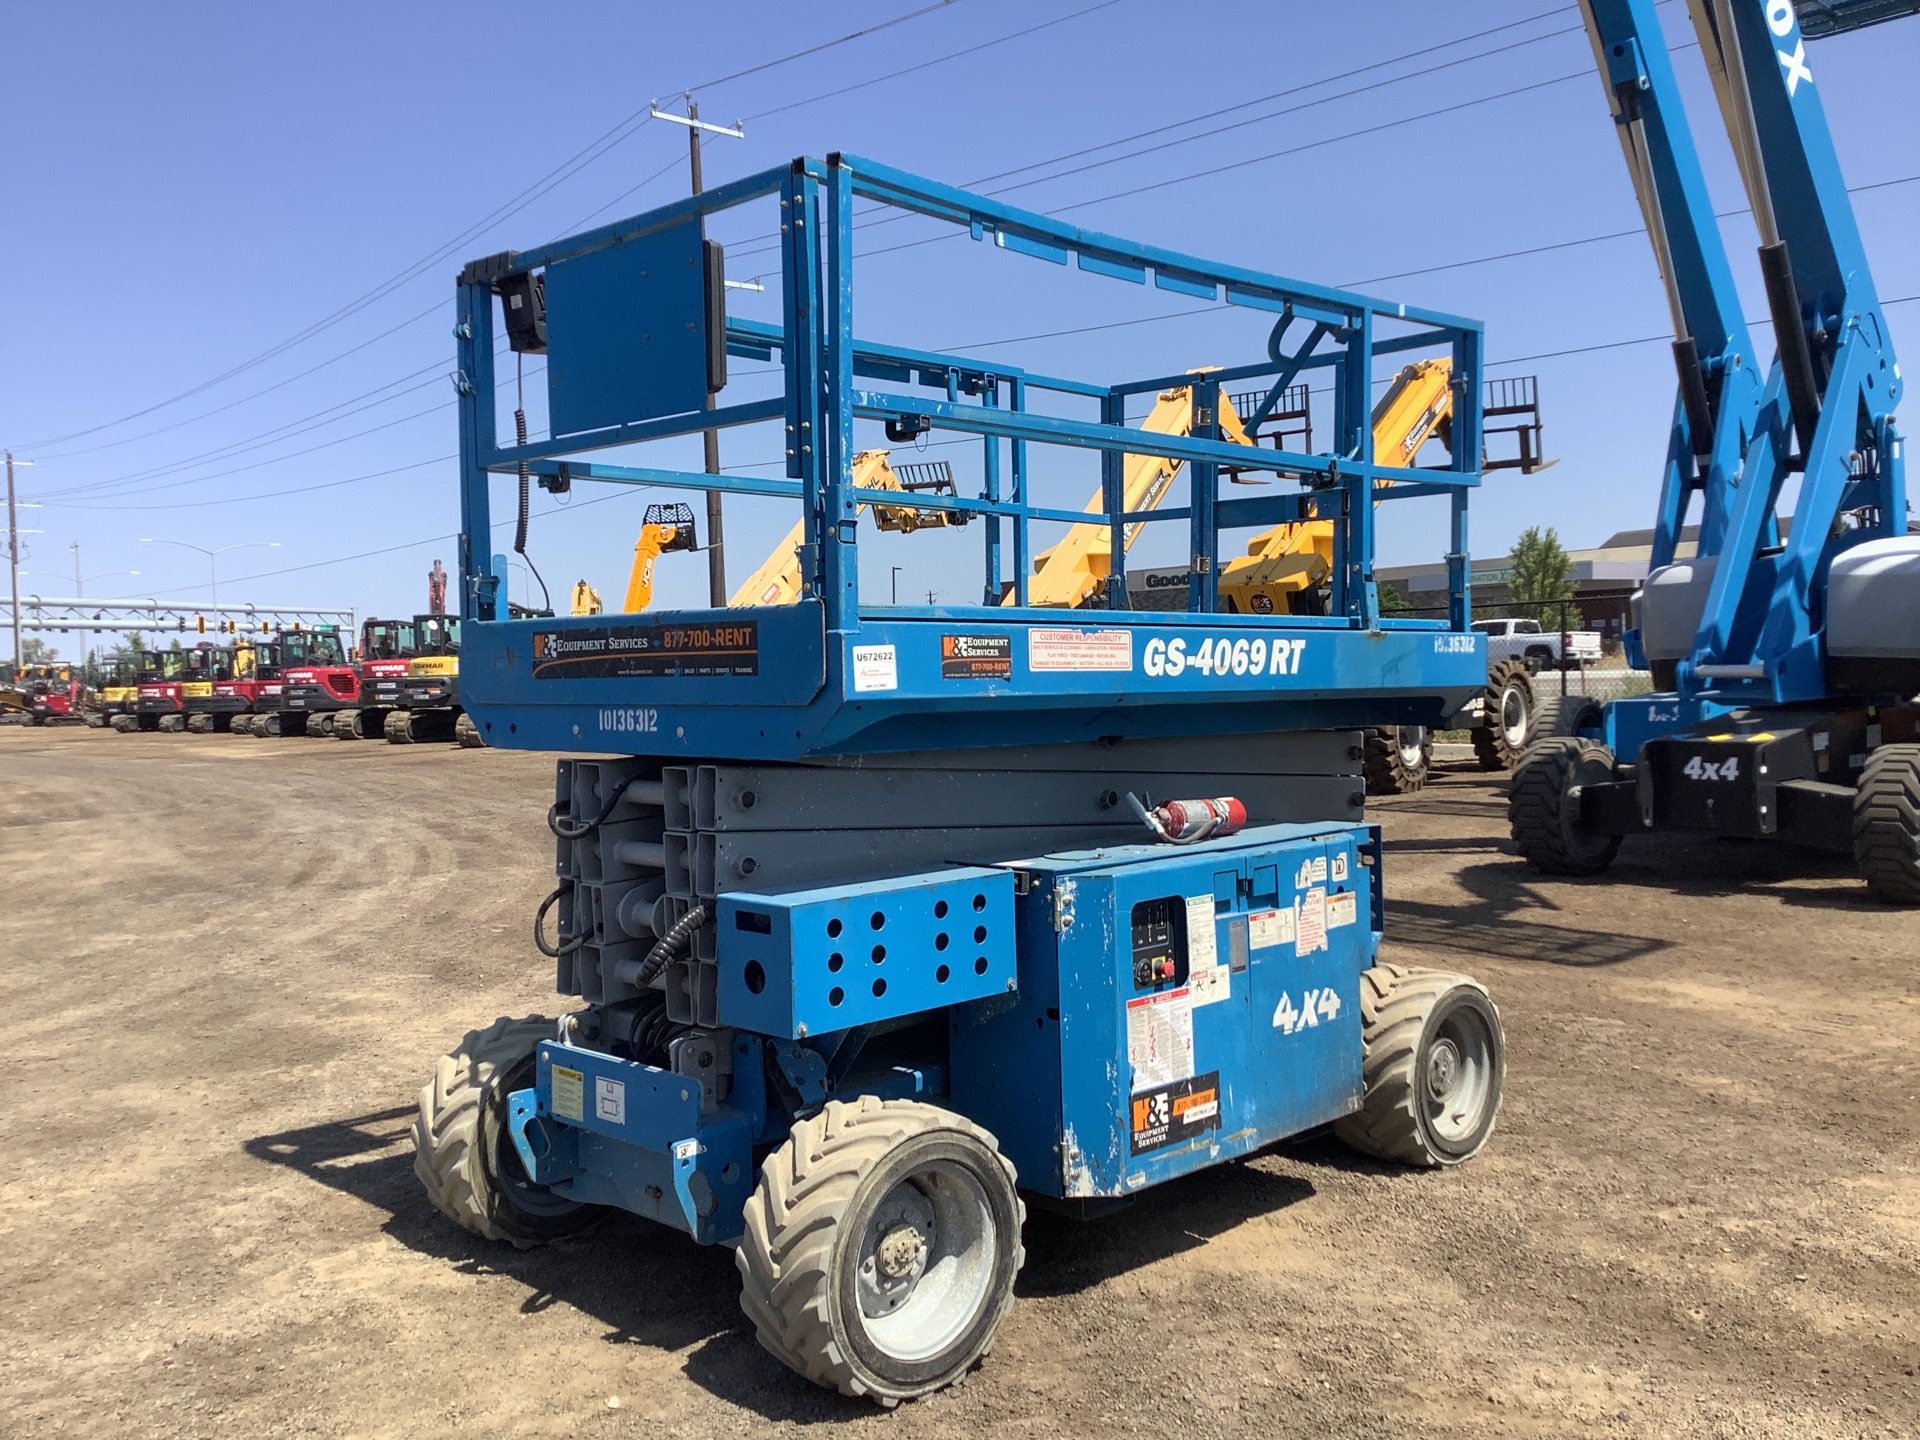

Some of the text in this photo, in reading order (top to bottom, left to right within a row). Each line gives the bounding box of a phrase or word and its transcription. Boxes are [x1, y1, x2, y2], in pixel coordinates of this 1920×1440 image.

[642, 557, 653, 589] JCB
[557, 639, 606, 652] EQUIPMENT
[608, 637, 648, 650] SERVICES
[664, 627, 752, 648] 877-700-RENT
[967, 637, 1009, 646] EQUIPMENT
[1040, 633, 1122, 642] CUSTOMER RESPONSIBILITY
[856, 652, 893, 662] U672622
[967, 647, 999, 656] SERVICES
[1143, 637, 1306, 677] GS-4069 RT
[371, 664, 405, 672] YANMAR
[971, 662, 1010, 671] 877-700-RENT
[599, 708, 658, 732] 10136312
[1683, 755, 1740, 782] 4x4
[1133, 1092, 1169, 1132] H&E
[1134, 1125, 1170, 1142] EQUIPMENT
[1138, 1133, 1167, 1148] SERVICES
